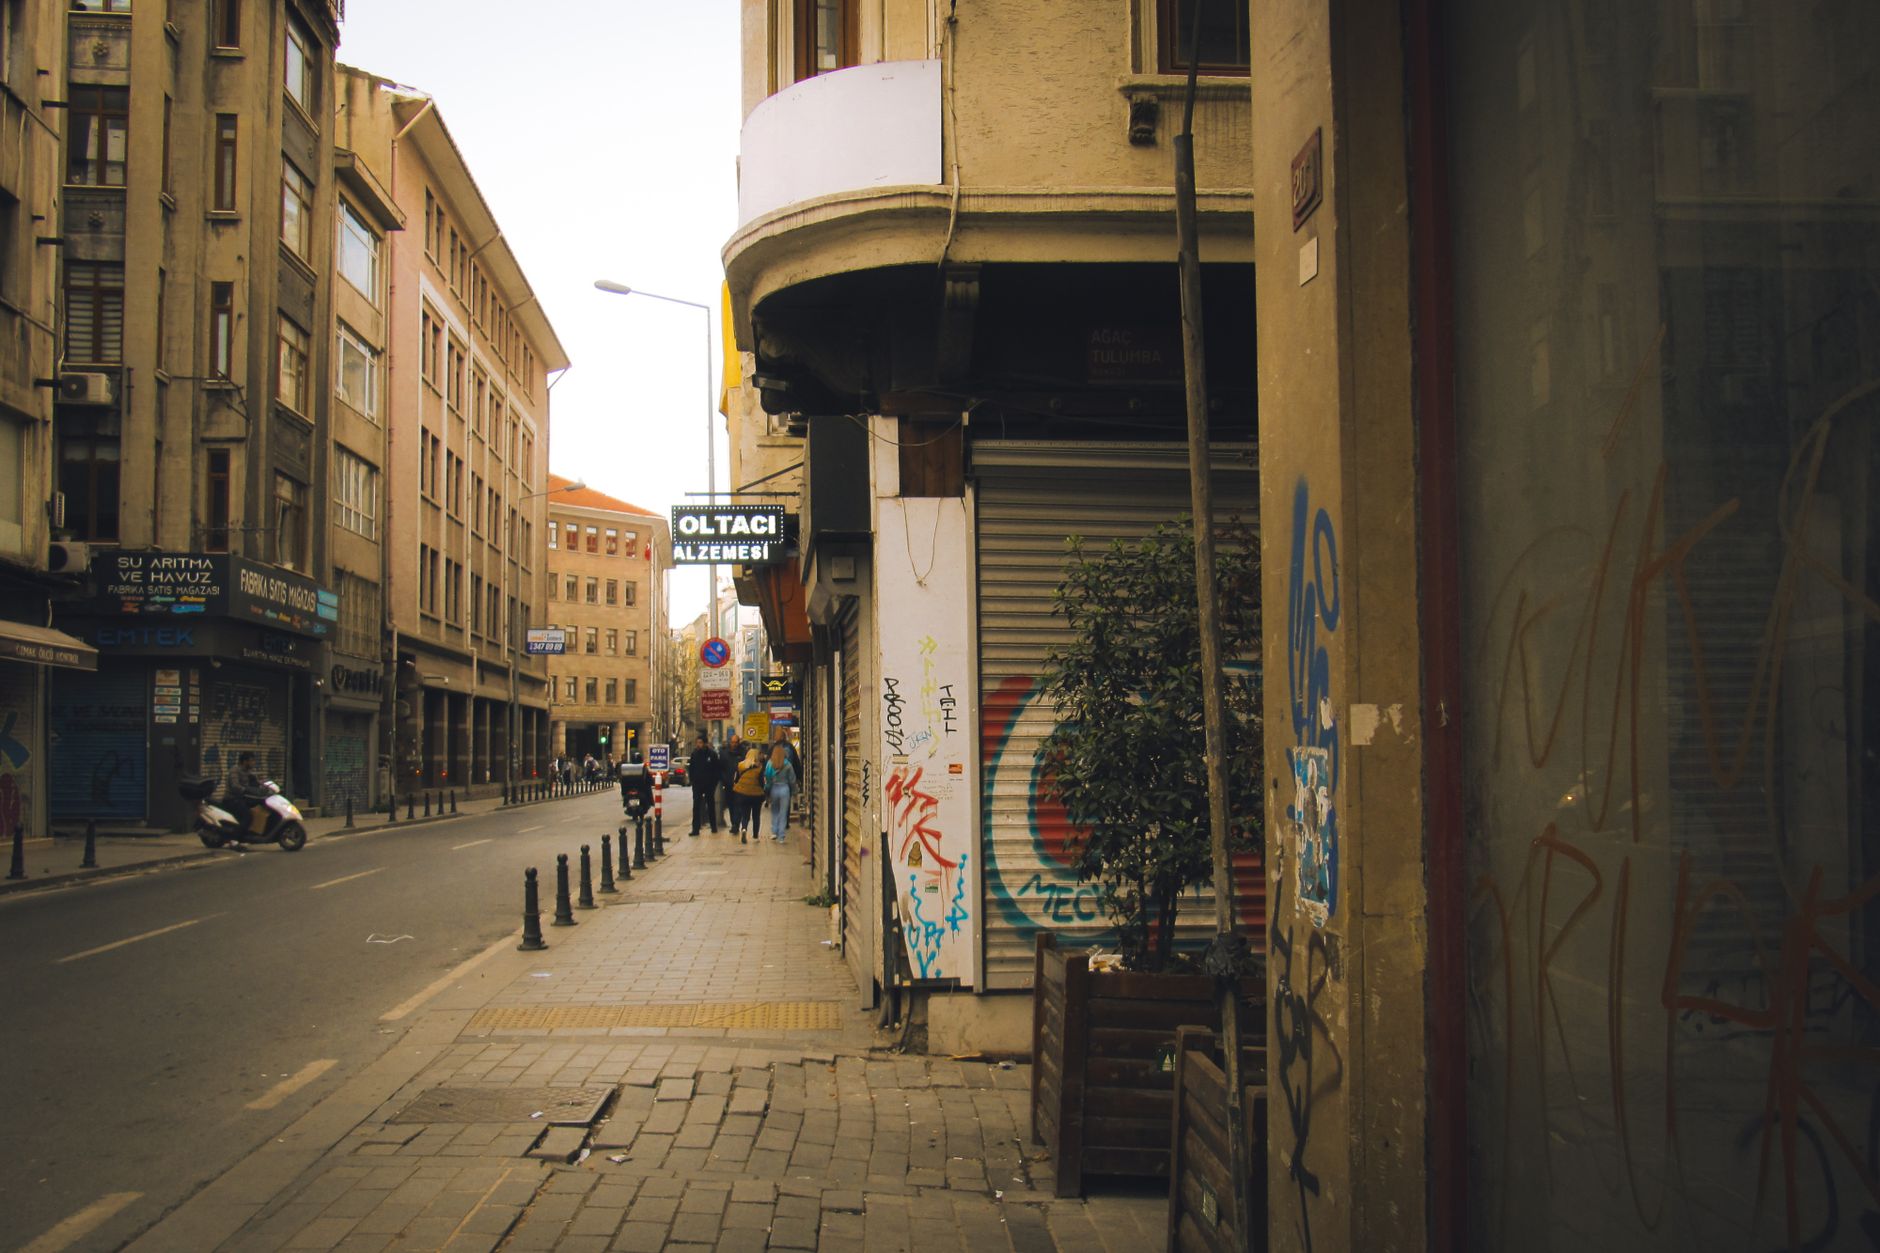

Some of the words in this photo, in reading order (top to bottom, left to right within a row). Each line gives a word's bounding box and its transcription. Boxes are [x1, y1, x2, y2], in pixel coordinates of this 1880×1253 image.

[1091, 350, 1161, 364] TULUMBA
[679, 515, 776, 535] OLTACI
[118, 557, 142, 568] SU
[150, 558, 213, 569] ARITMA
[119, 572, 143, 582] VE
[151, 572, 211, 583] HAVUZ
[97, 627, 193, 647] EMTEK
